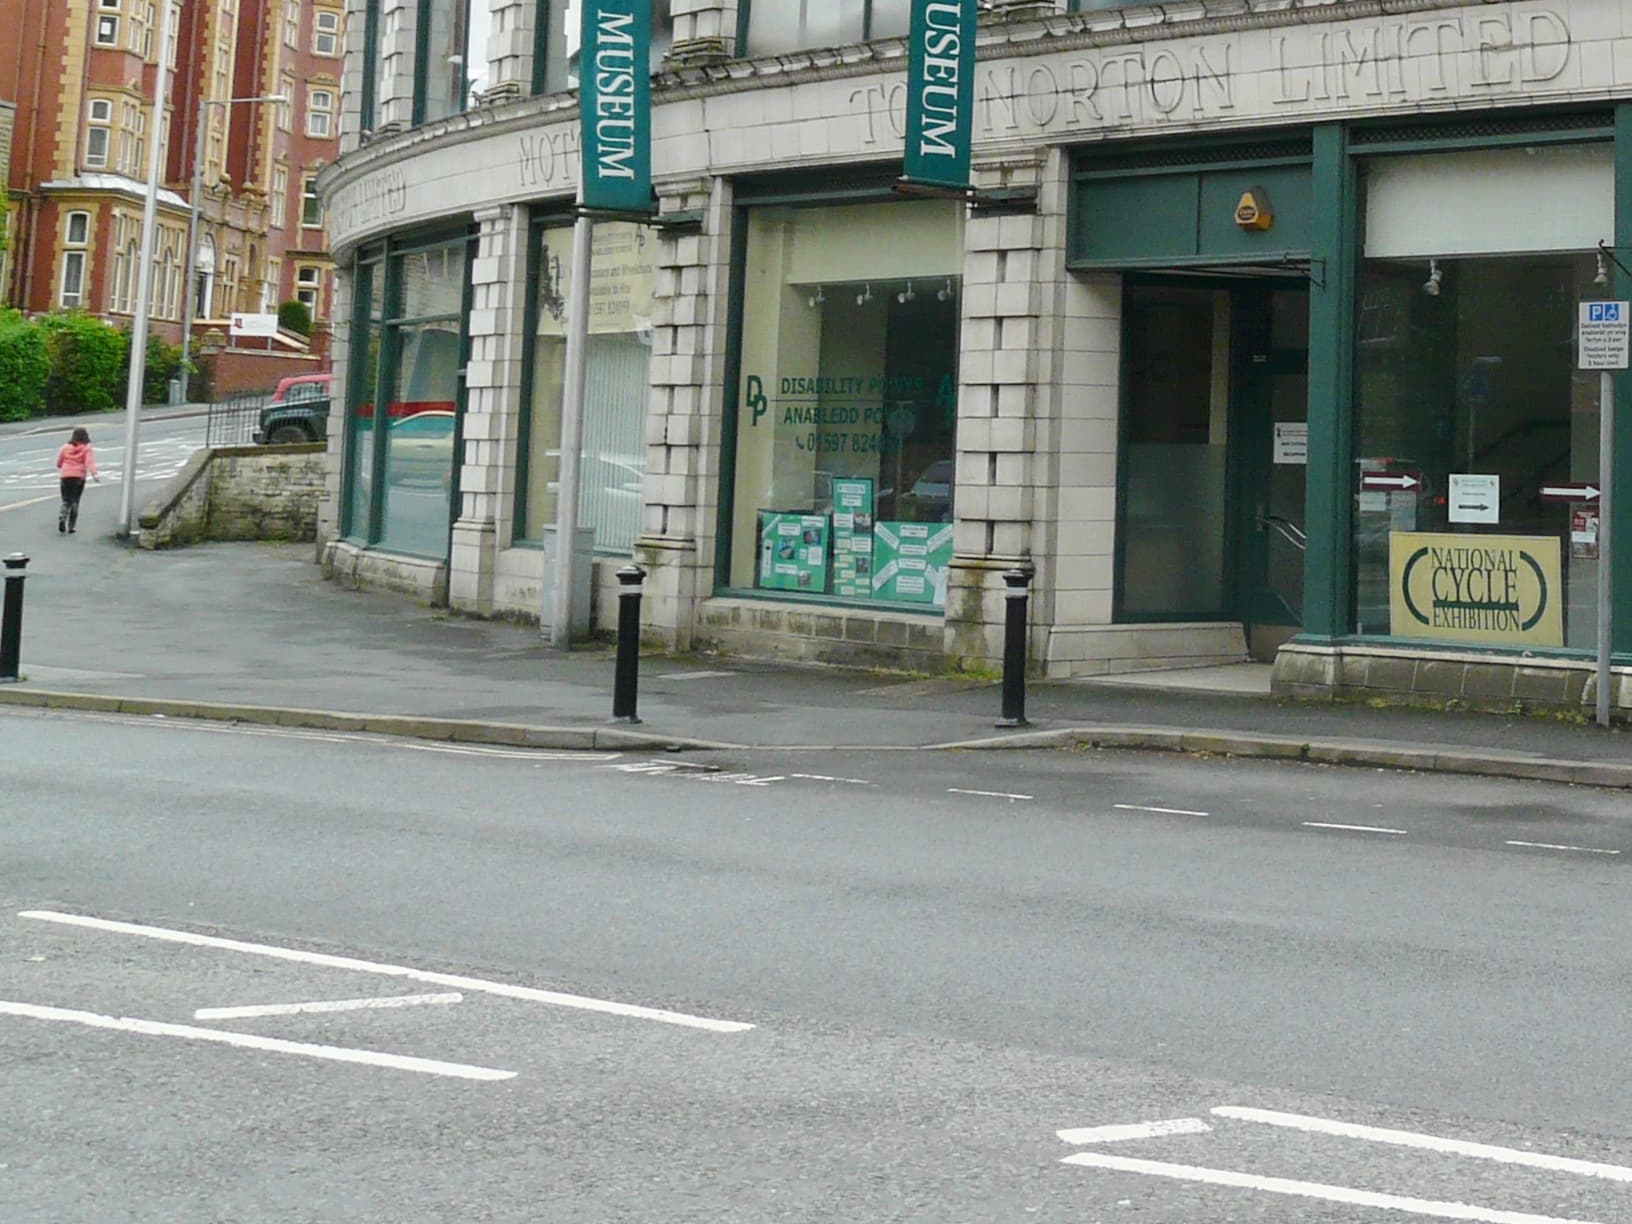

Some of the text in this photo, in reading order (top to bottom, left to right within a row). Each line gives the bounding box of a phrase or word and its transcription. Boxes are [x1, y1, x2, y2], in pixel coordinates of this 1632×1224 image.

[982, 38, 1235, 137] NORTON
[1271, 8, 1571, 106] LIMITED
[594, 11, 637, 180] MUSEUM
[519, 127, 580, 187] MOT
[781, 376, 865, 395] DISABILITY
[783, 407, 860, 425] ANABLEDD
[807, 433, 847, 453] 01597
[1431, 547, 1518, 572] NATIONAL
[1431, 567, 1519, 604] CYCLE
[1433, 607, 1520, 632] EXHIBITION
